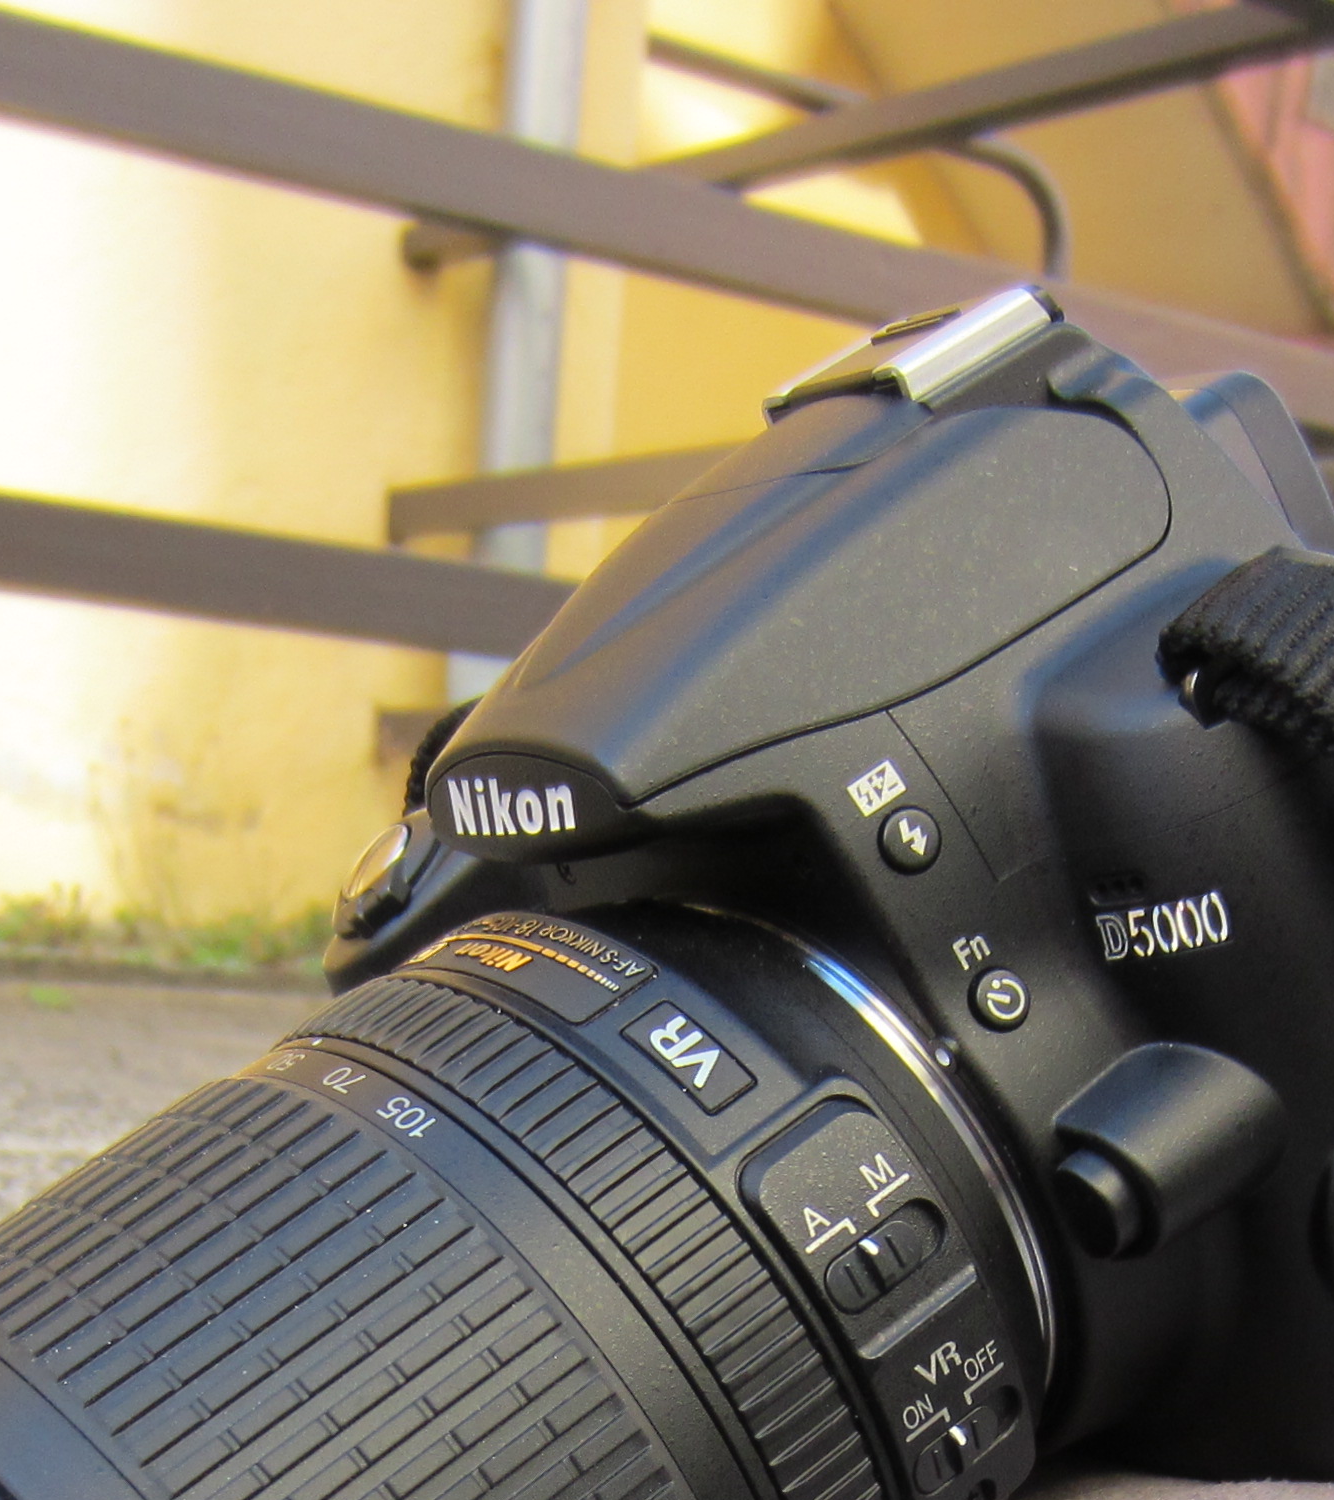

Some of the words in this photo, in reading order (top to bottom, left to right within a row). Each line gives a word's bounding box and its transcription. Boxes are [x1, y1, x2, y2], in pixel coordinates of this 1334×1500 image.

[448, 778, 576, 836] Nikon
[538, 924, 607, 957] NIKKOR
[952, 933, 992, 970] Fn
[1095, 891, 1230, 961] D5000
[453, 942, 534, 973] Nikon
[599, 949, 646, 977] AF-S
[647, 1014, 723, 1090] VR
[322, 1066, 368, 1094] 70
[375, 1096, 438, 1139] 105
[801, 1206, 832, 1238] A
[858, 1152, 897, 1191] M
[901, 1393, 935, 1431] ON
[963, 1339, 1000, 1382] OFF
[914, 1340, 963, 1385] VR
